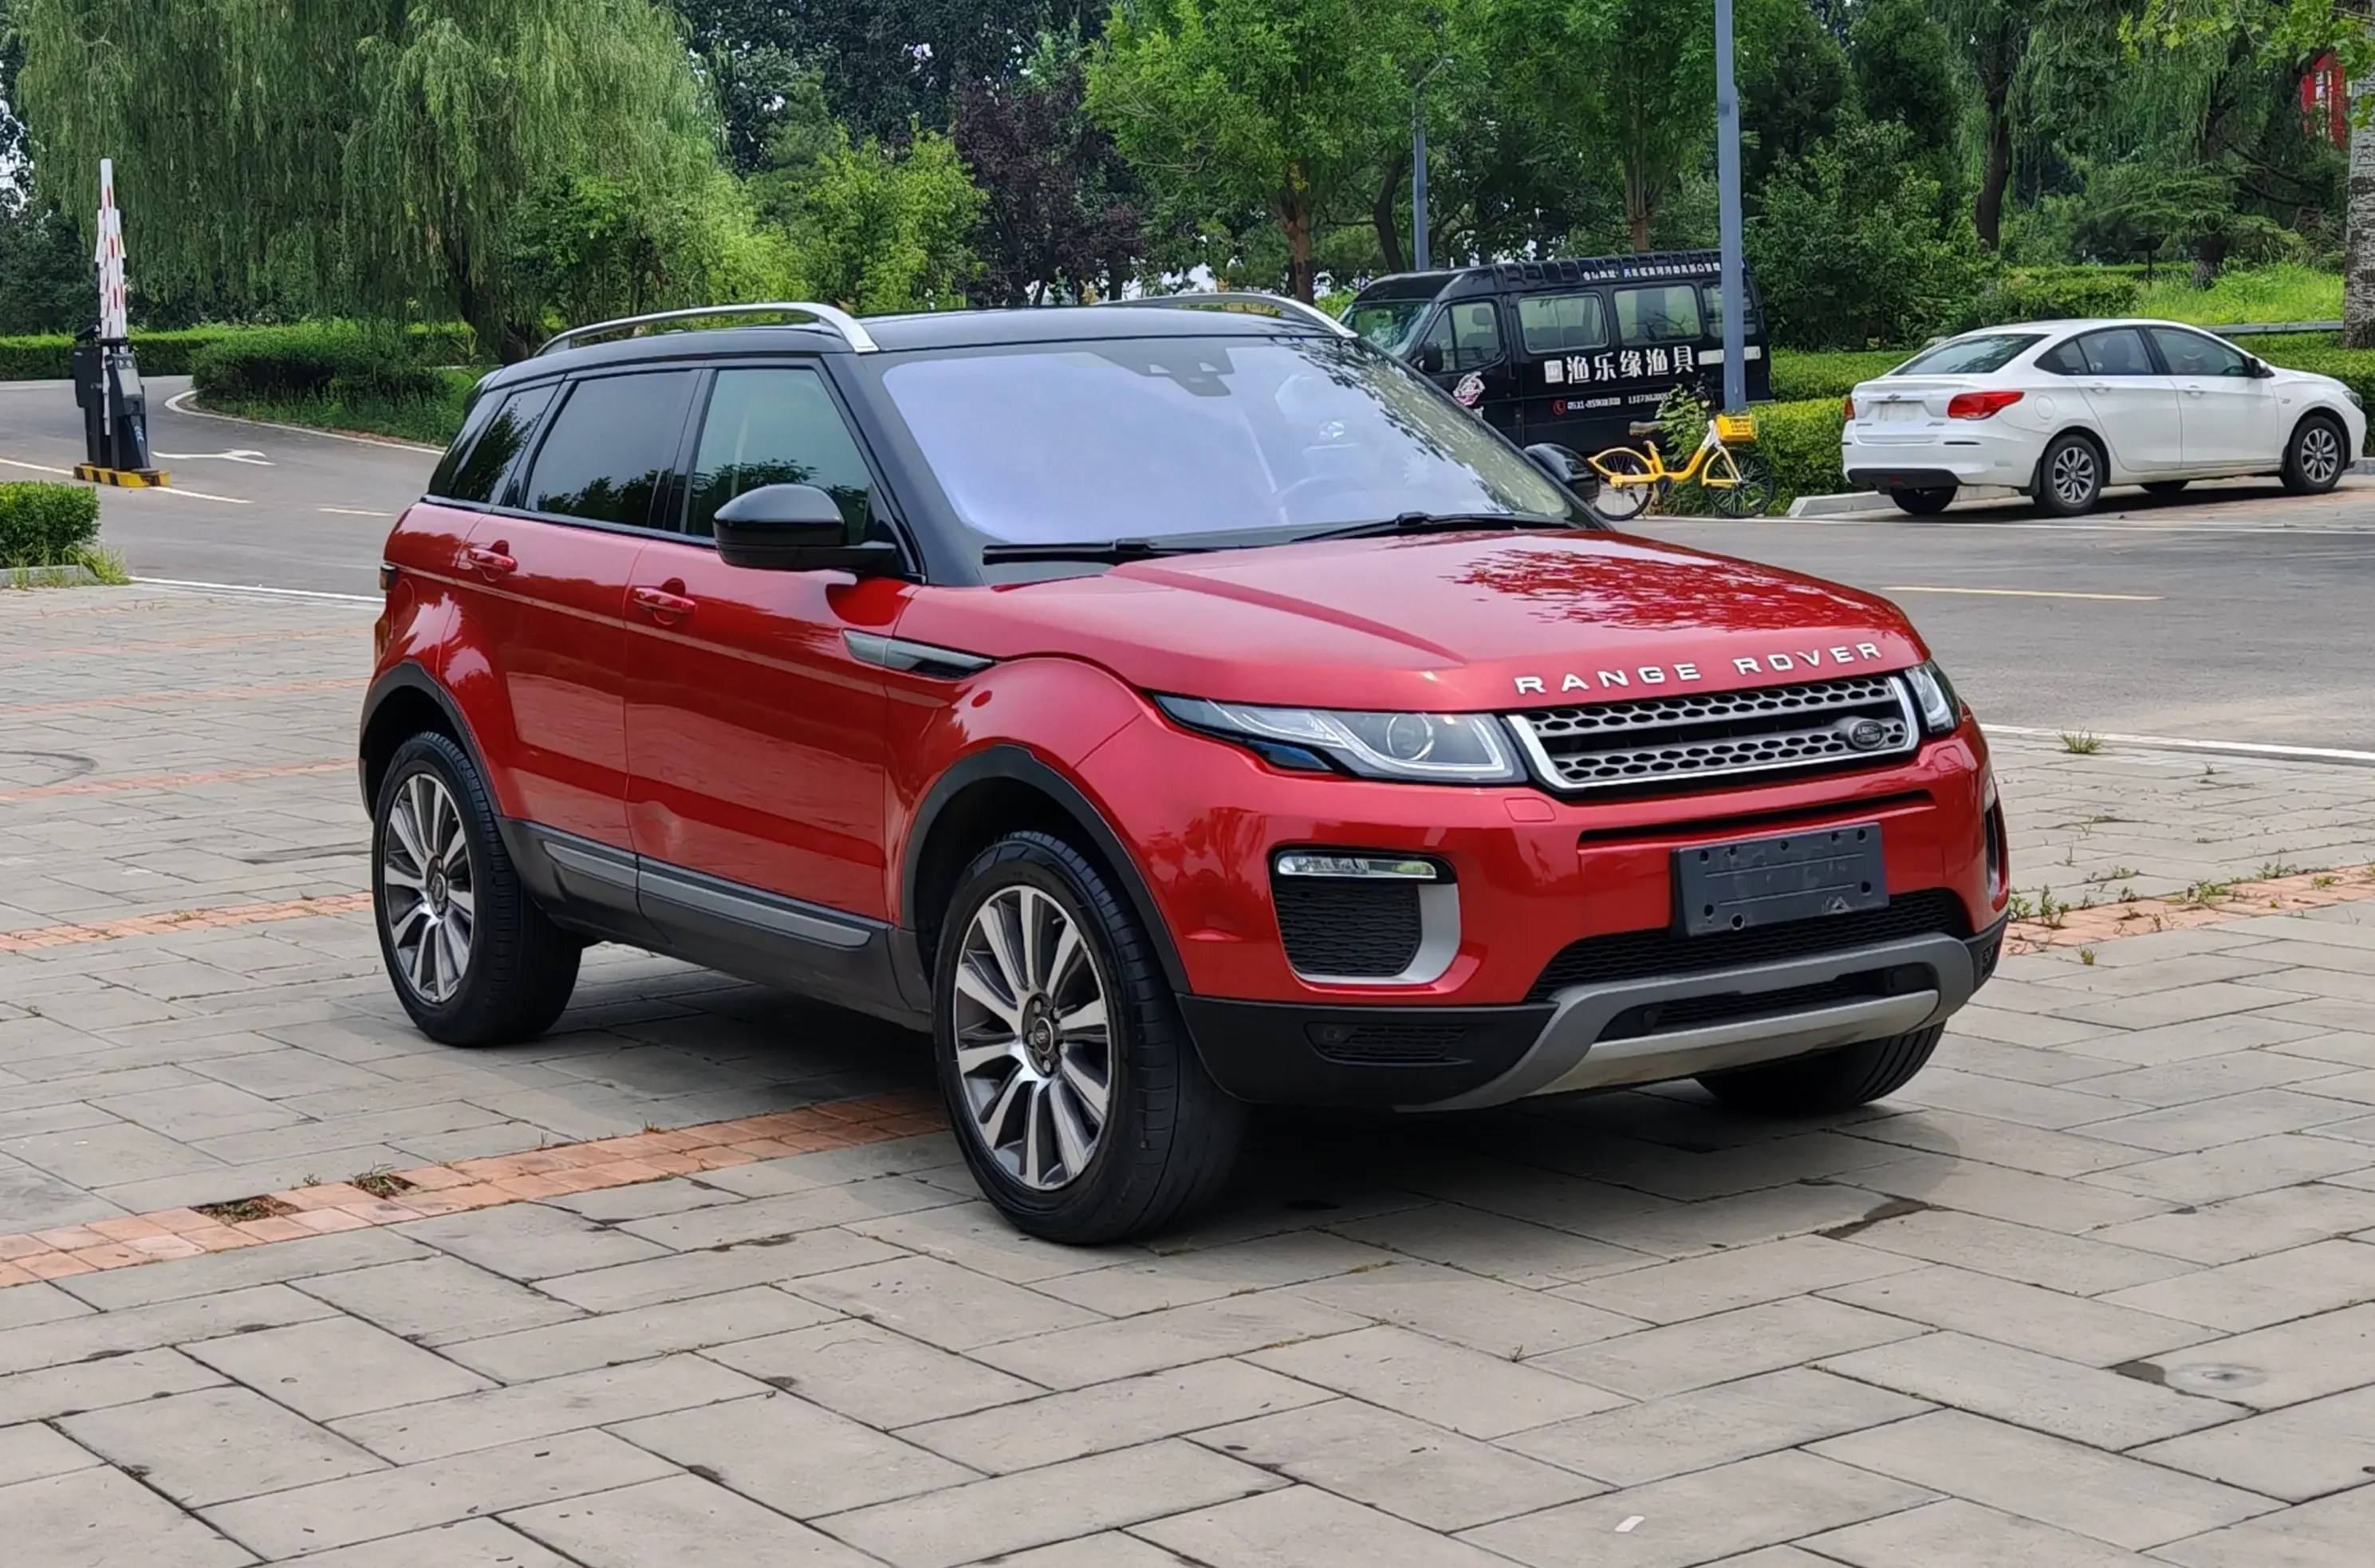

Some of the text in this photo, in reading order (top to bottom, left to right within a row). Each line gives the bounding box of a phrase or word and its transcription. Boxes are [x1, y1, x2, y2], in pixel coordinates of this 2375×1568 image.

[1566, 345, 1694, 384] 渔乐缘渔具
[1514, 641, 1883, 695] RANGE ROVER
